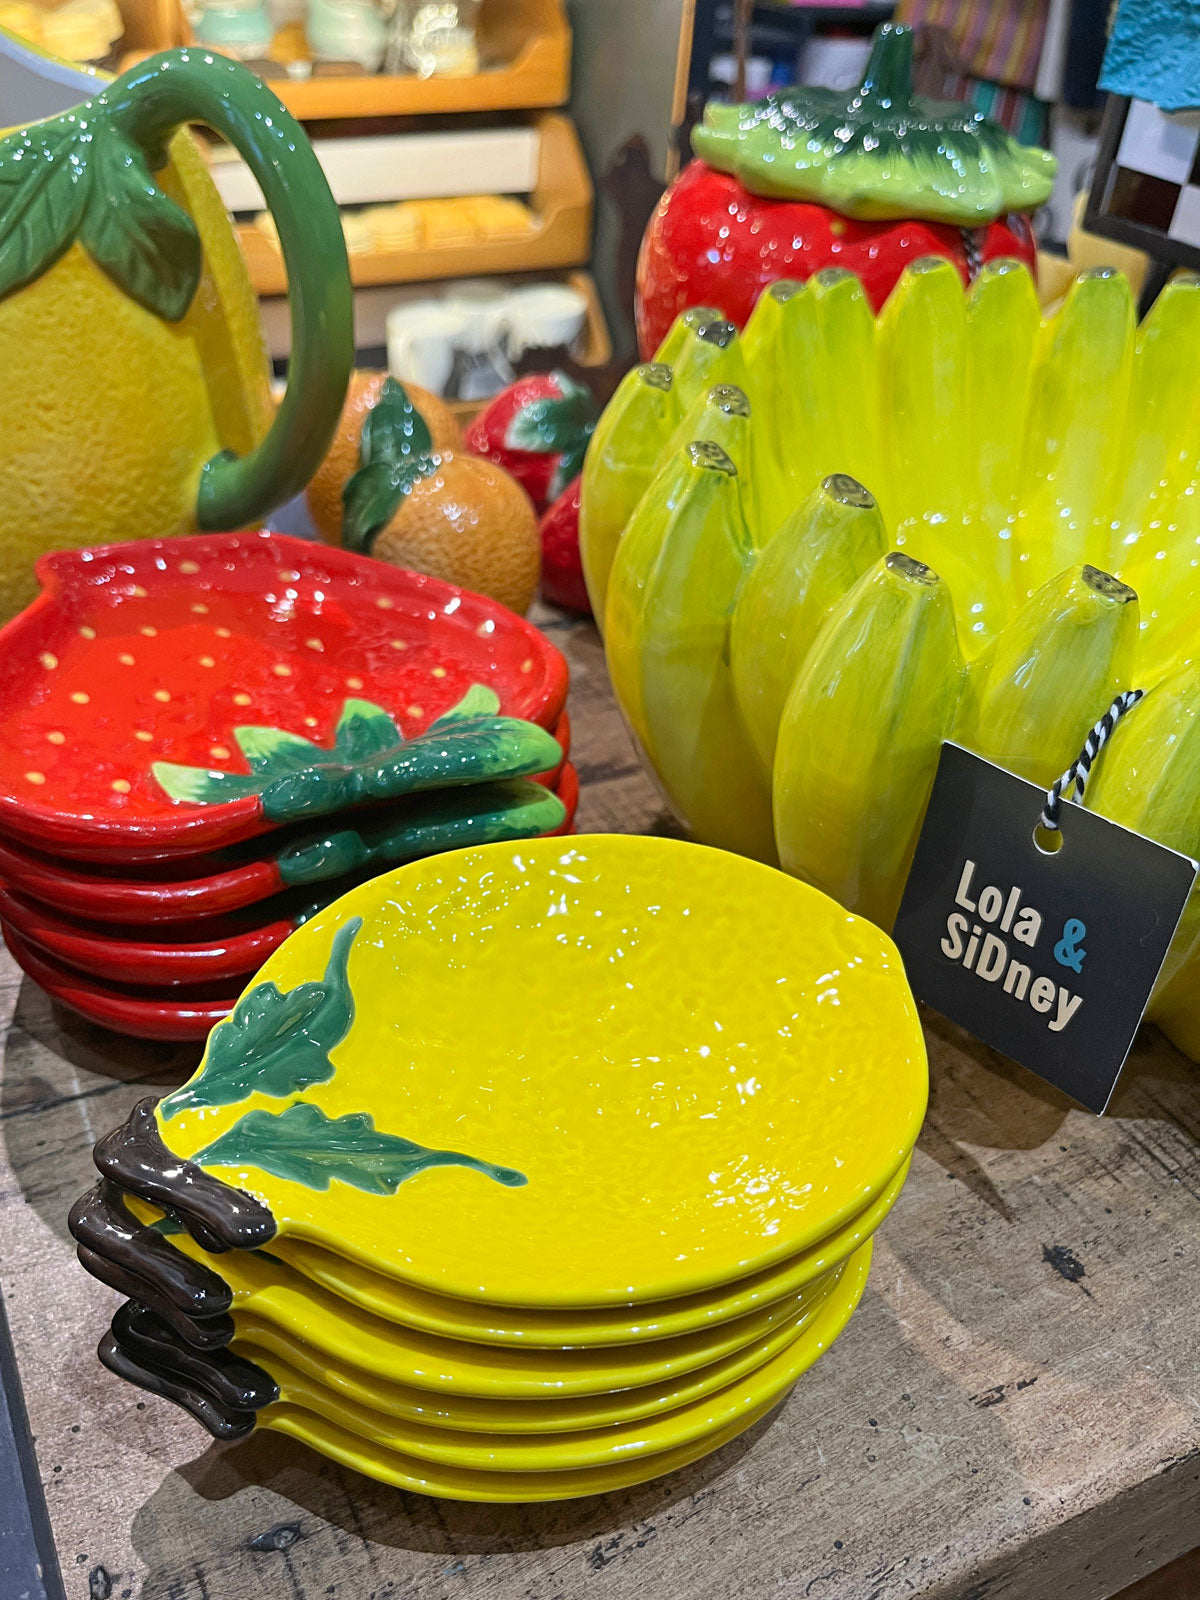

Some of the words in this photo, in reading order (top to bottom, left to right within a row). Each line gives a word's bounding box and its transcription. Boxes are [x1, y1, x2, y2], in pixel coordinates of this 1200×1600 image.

[940, 912, 1083, 1032] SiDney
[954, 859, 1042, 947] Lola
[1053, 918, 1087, 974] &
